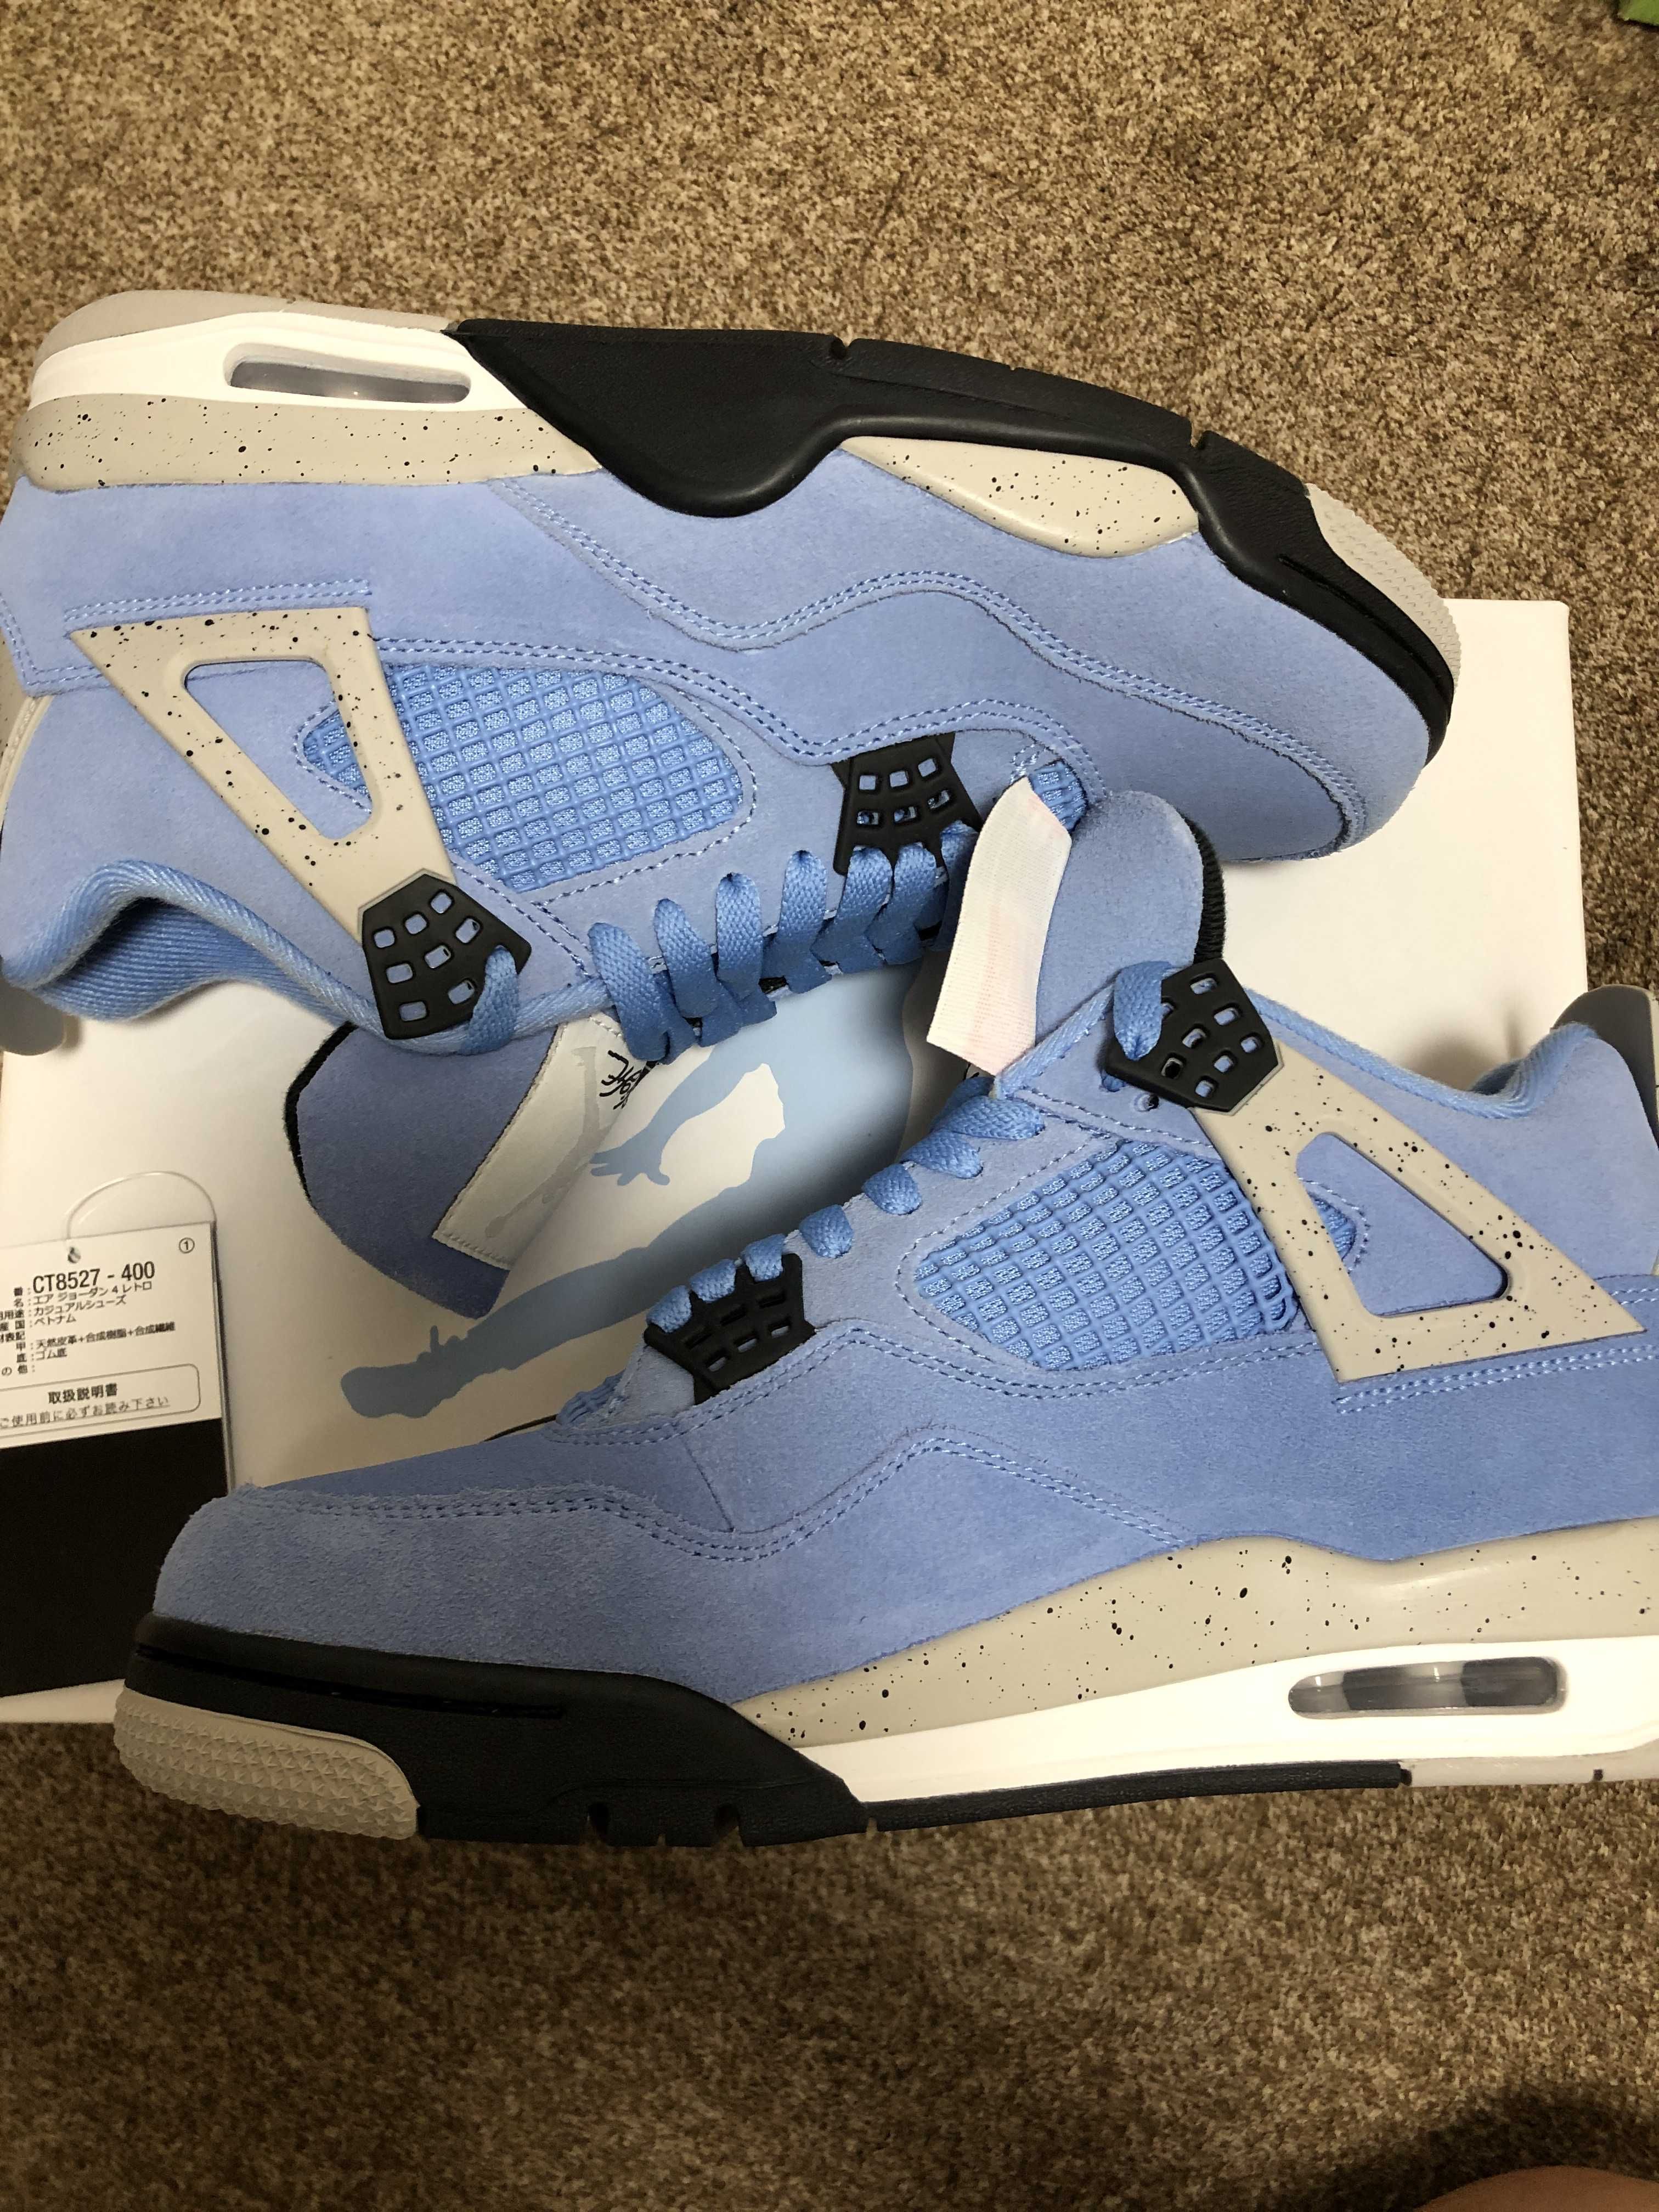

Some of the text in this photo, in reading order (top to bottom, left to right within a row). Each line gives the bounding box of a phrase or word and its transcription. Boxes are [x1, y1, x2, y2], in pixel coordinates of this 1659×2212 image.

[34, 1295, 126, 1316] カジュアルシューズ
[48, 1383, 117, 1404] 取扱説明書
